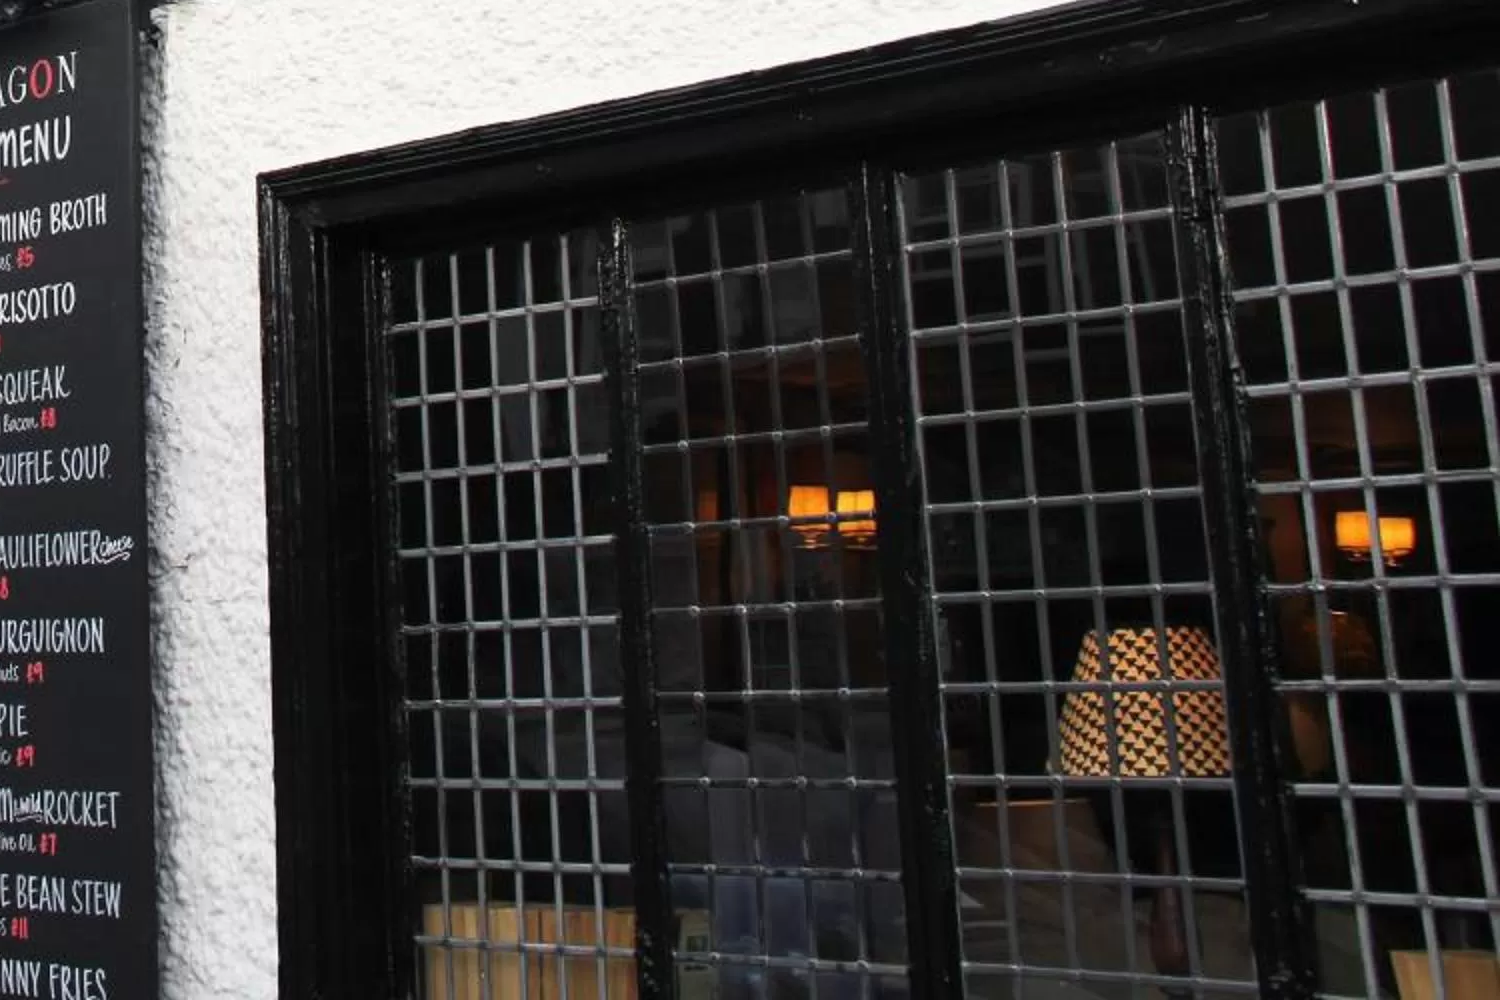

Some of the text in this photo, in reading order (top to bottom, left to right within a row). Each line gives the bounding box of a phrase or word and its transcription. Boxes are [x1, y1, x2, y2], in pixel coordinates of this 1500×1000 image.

[50, 193, 107, 235] BROTH
[3, 412, 39, 433] Bacon
[43, 790, 120, 829] ROCKET
[17, 873, 66, 913] BEAN
[71, 879, 121, 919] STEW
[49, 963, 107, 1000] FRIES
